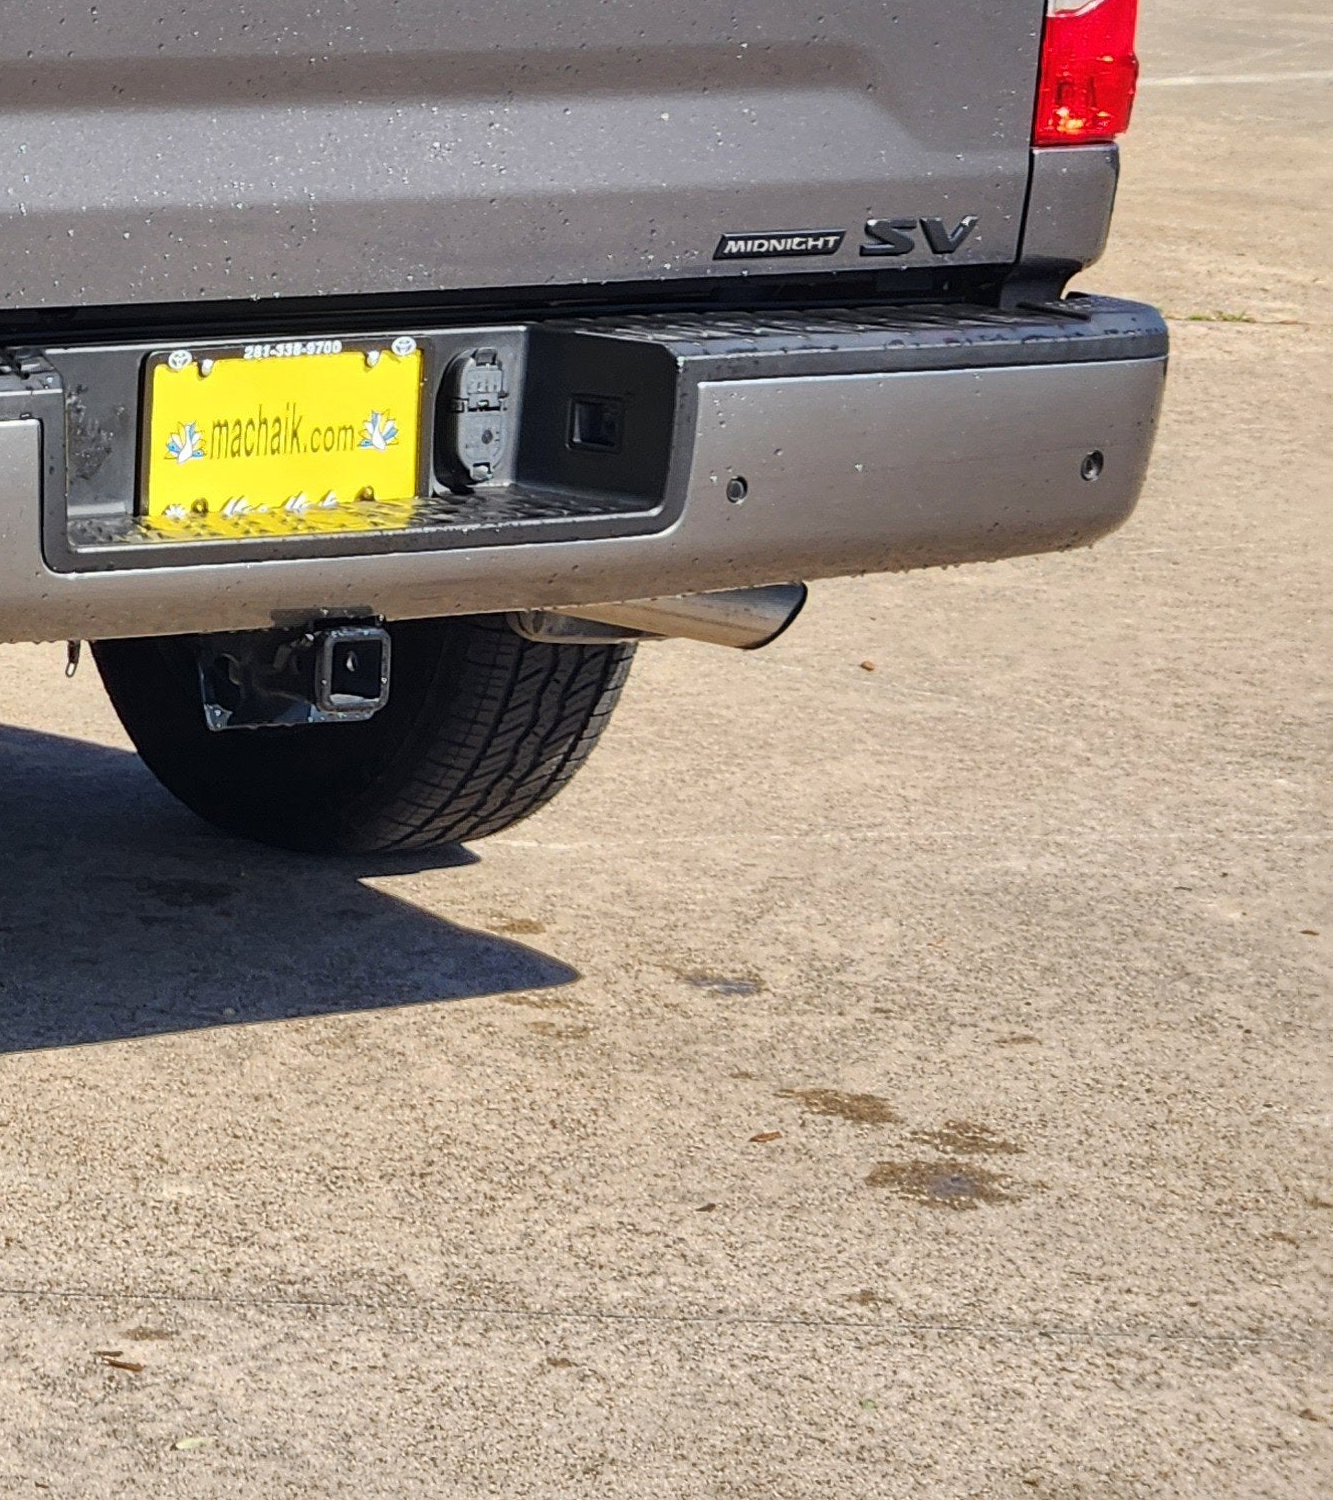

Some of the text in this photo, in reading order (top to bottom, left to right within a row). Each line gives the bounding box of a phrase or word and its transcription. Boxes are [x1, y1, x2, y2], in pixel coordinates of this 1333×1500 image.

[723, 214, 980, 257] MIDNIGHT SV
[209, 401, 355, 460] machaik.com
